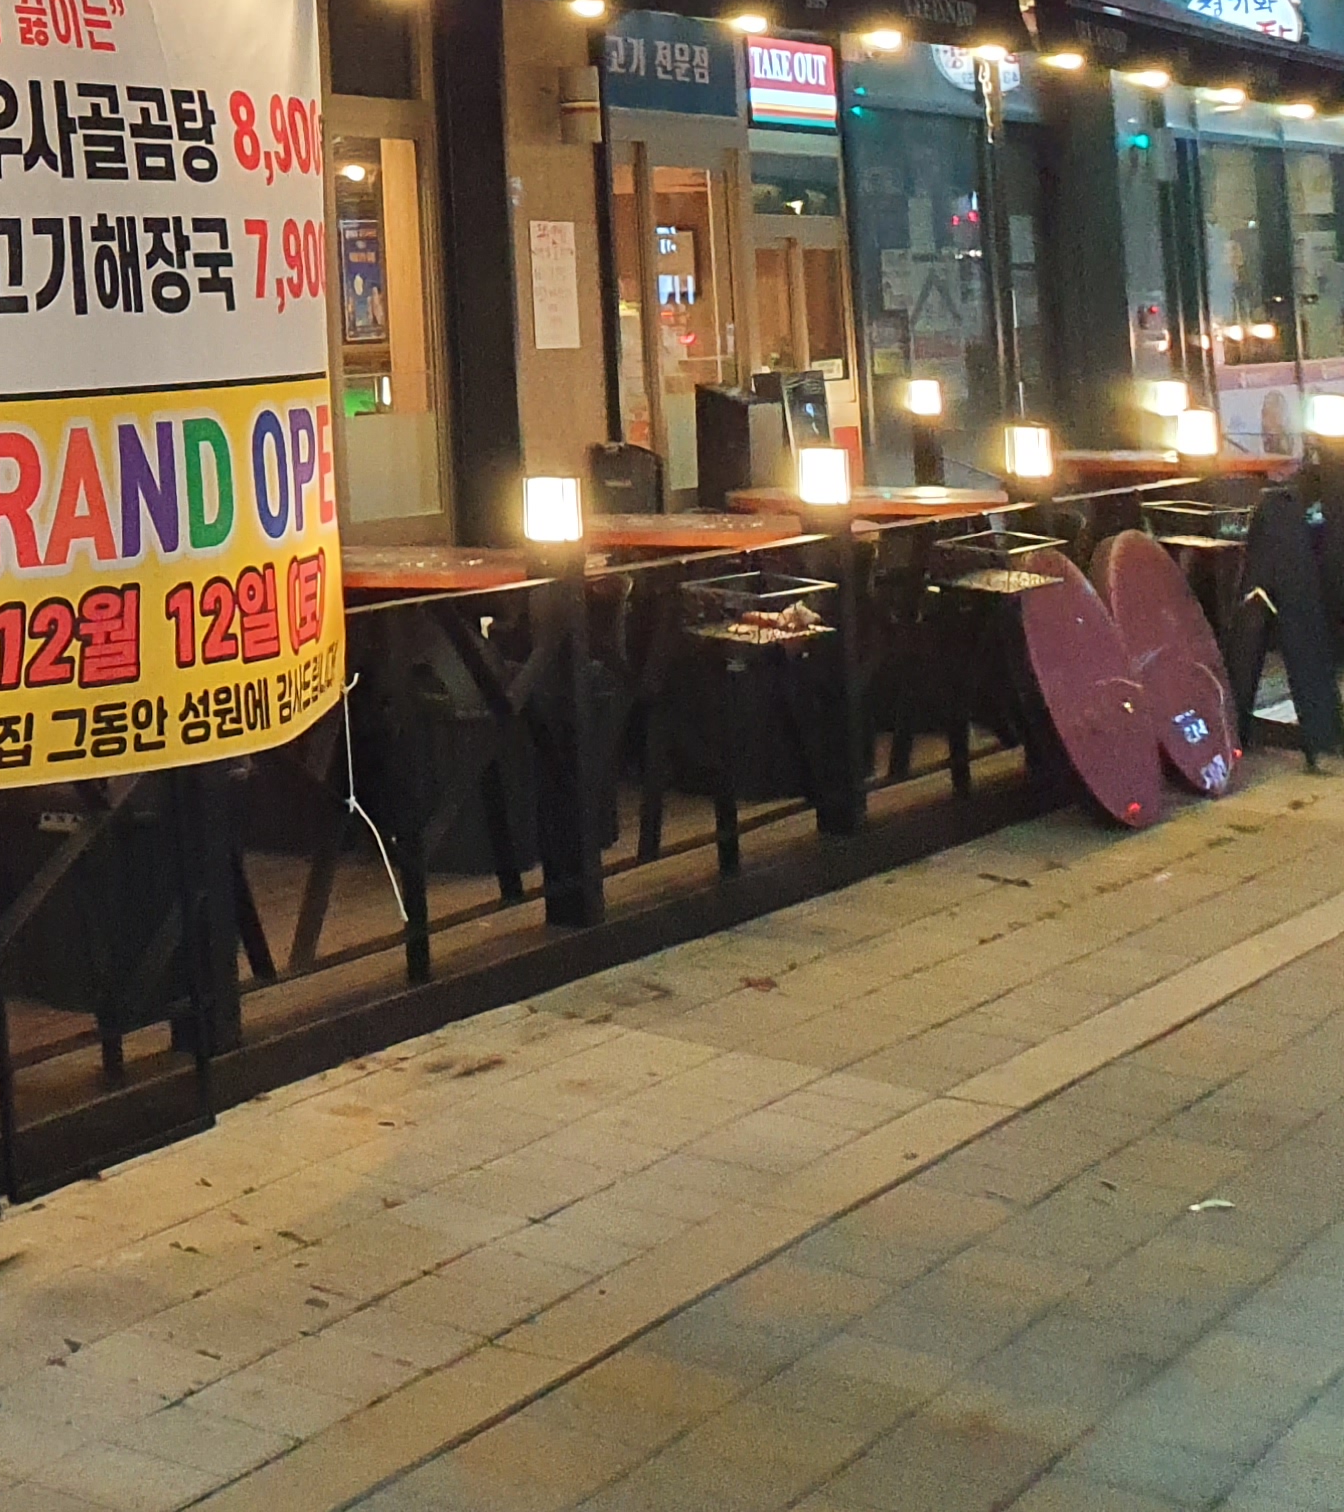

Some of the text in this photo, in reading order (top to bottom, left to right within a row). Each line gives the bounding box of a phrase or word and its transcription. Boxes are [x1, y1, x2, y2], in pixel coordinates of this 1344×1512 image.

[654, 40, 711, 85] 전문점
[750, 46, 828, 87] TAKE OUT
[165, 561, 280, 669] 12일
[45, 694, 169, 763] 그동안
[178, 676, 271, 745] 성원에
